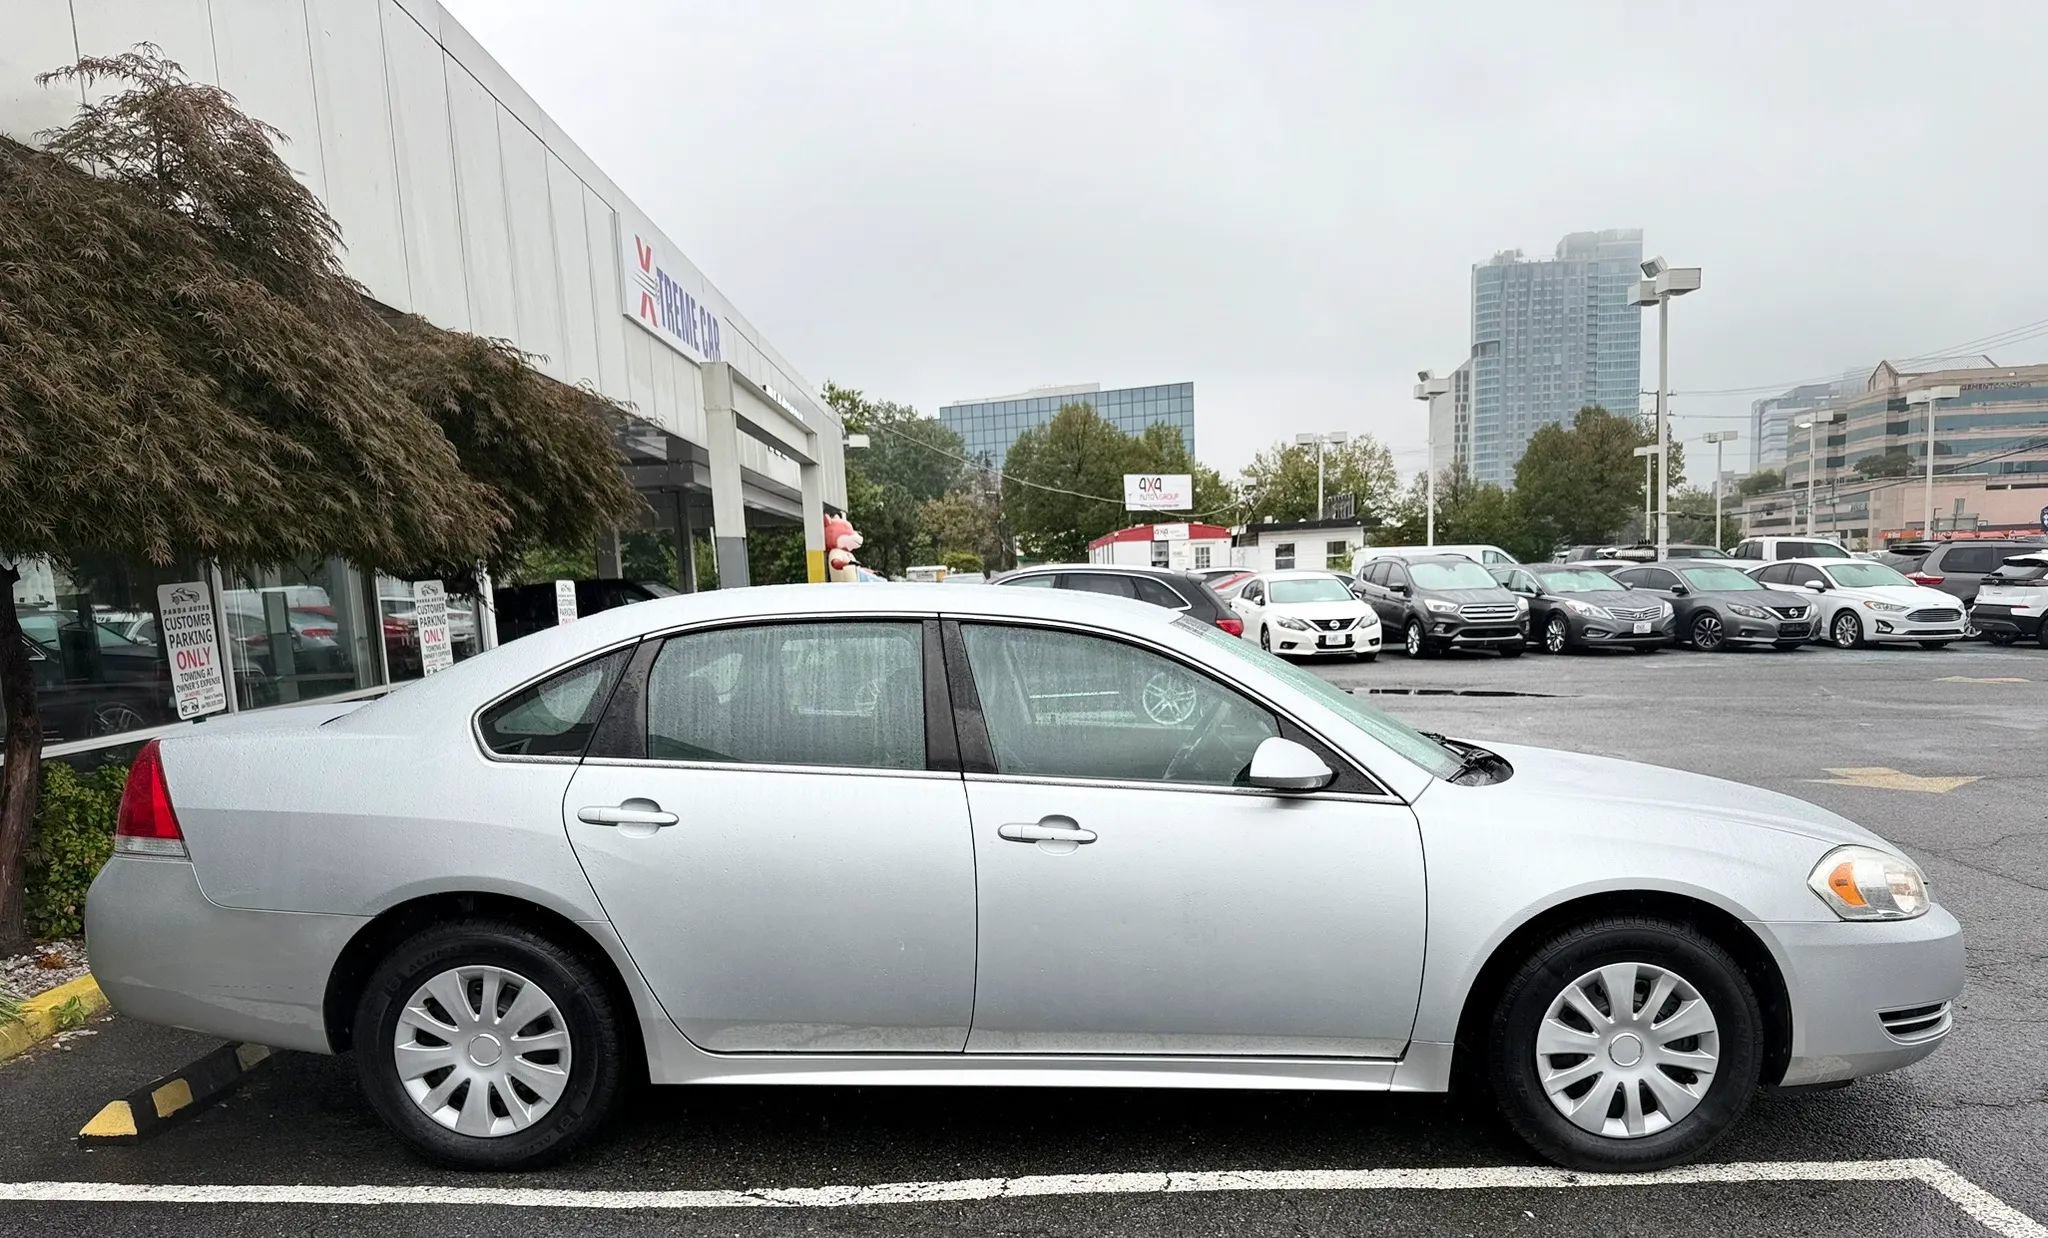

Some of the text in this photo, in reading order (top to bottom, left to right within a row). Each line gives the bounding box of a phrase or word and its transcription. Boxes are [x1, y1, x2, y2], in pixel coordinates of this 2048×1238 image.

[634, 233, 721, 362] XTREME CAR
[417, 603, 445, 615] CUSTOMER
[164, 613, 212, 631] CUSTOMER
[419, 614, 446, 628] PARKING
[169, 628, 213, 649] PARKING
[424, 628, 445, 644] ONLY
[176, 646, 211, 671] ONLY
[180, 667, 214, 683] TOWING AT
[176, 682, 200, 693] OWNER'S
[200, 676, 221, 688] EXPENSE
